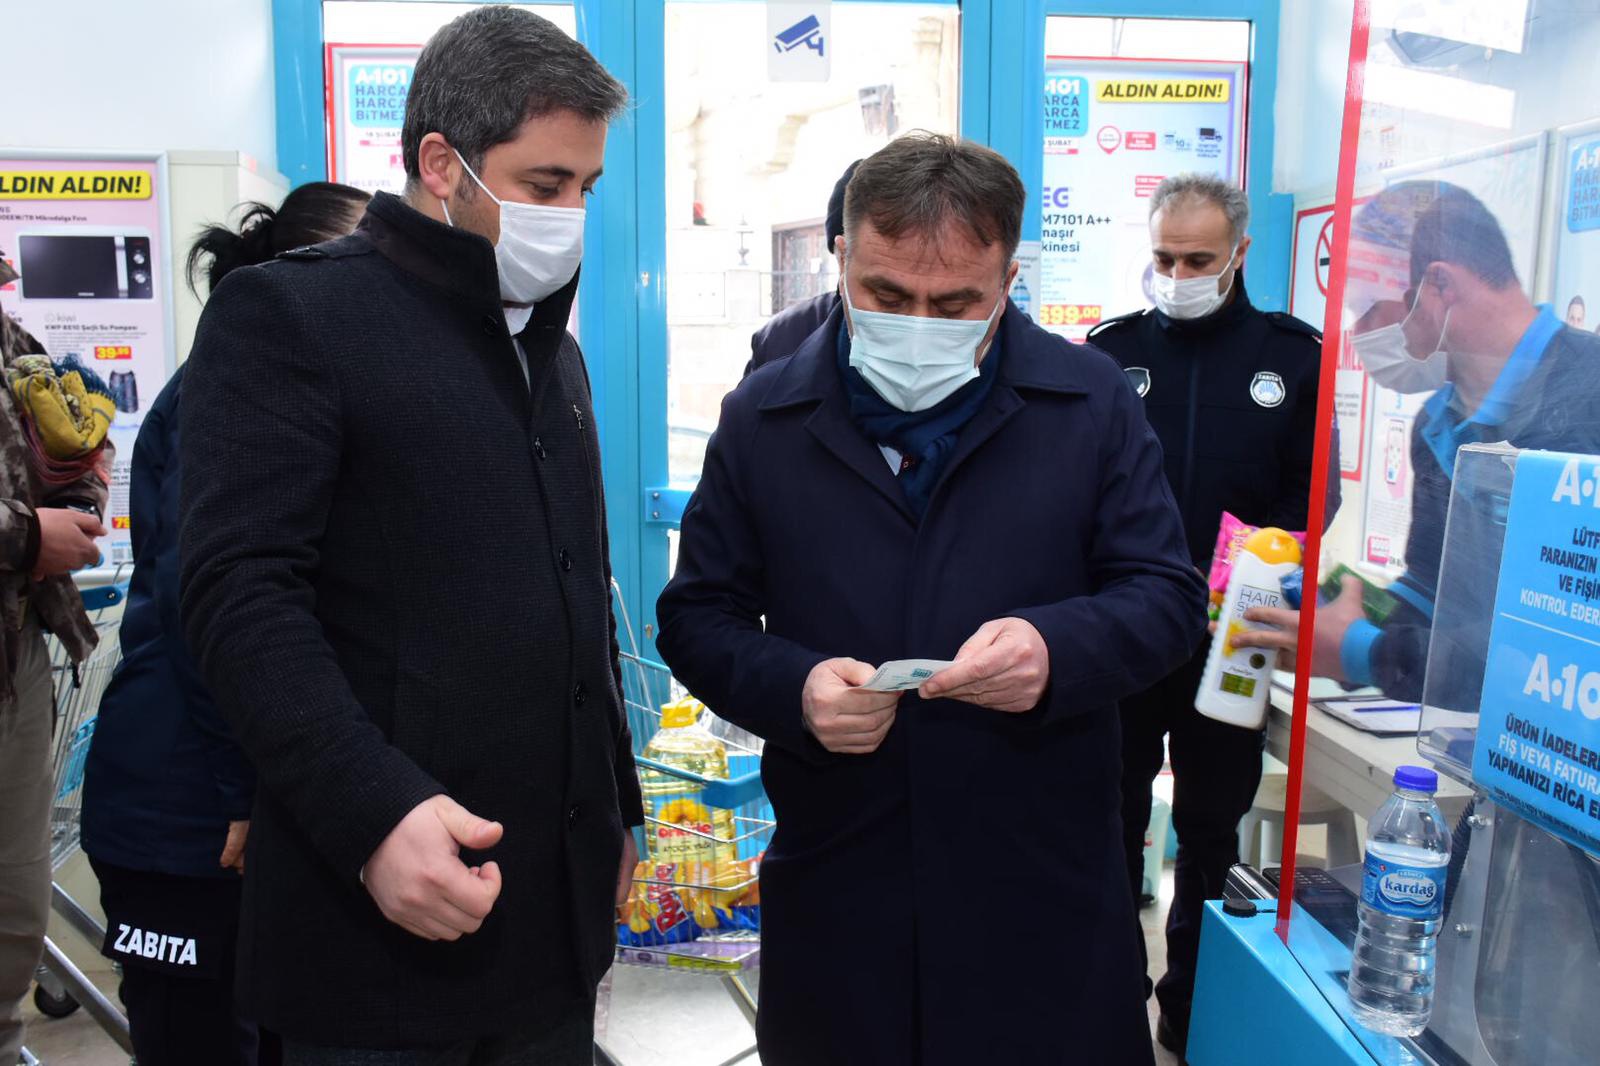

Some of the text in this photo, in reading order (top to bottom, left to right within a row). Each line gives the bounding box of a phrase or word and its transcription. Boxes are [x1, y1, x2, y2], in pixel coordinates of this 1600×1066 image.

[355, 85, 407, 96] HARCA
[1102, 84, 1223, 98] ALDIN ALDIN!
[60, 175, 142, 194] ALDIN!
[1085, 214, 1112, 226] A++
[1041, 241, 1080, 253] kinesi
[1540, 545, 1598, 574] PARANIZIN
[1559, 573, 1574, 593] VE
[1240, 587, 1280, 608] HAIR
[1519, 587, 1600, 627] KONTROL EDER
[1505, 711, 1540, 745] ÜRÜN
[1498, 733, 1518, 759] FİŞ
[1520, 743, 1551, 771] VEYA
[1487, 748, 1551, 795] YAPMANIZI
[1553, 781, 1585, 814] RİCA
[1384, 876, 1434, 898] kardağ
[113, 923, 197, 965] ZABITA
